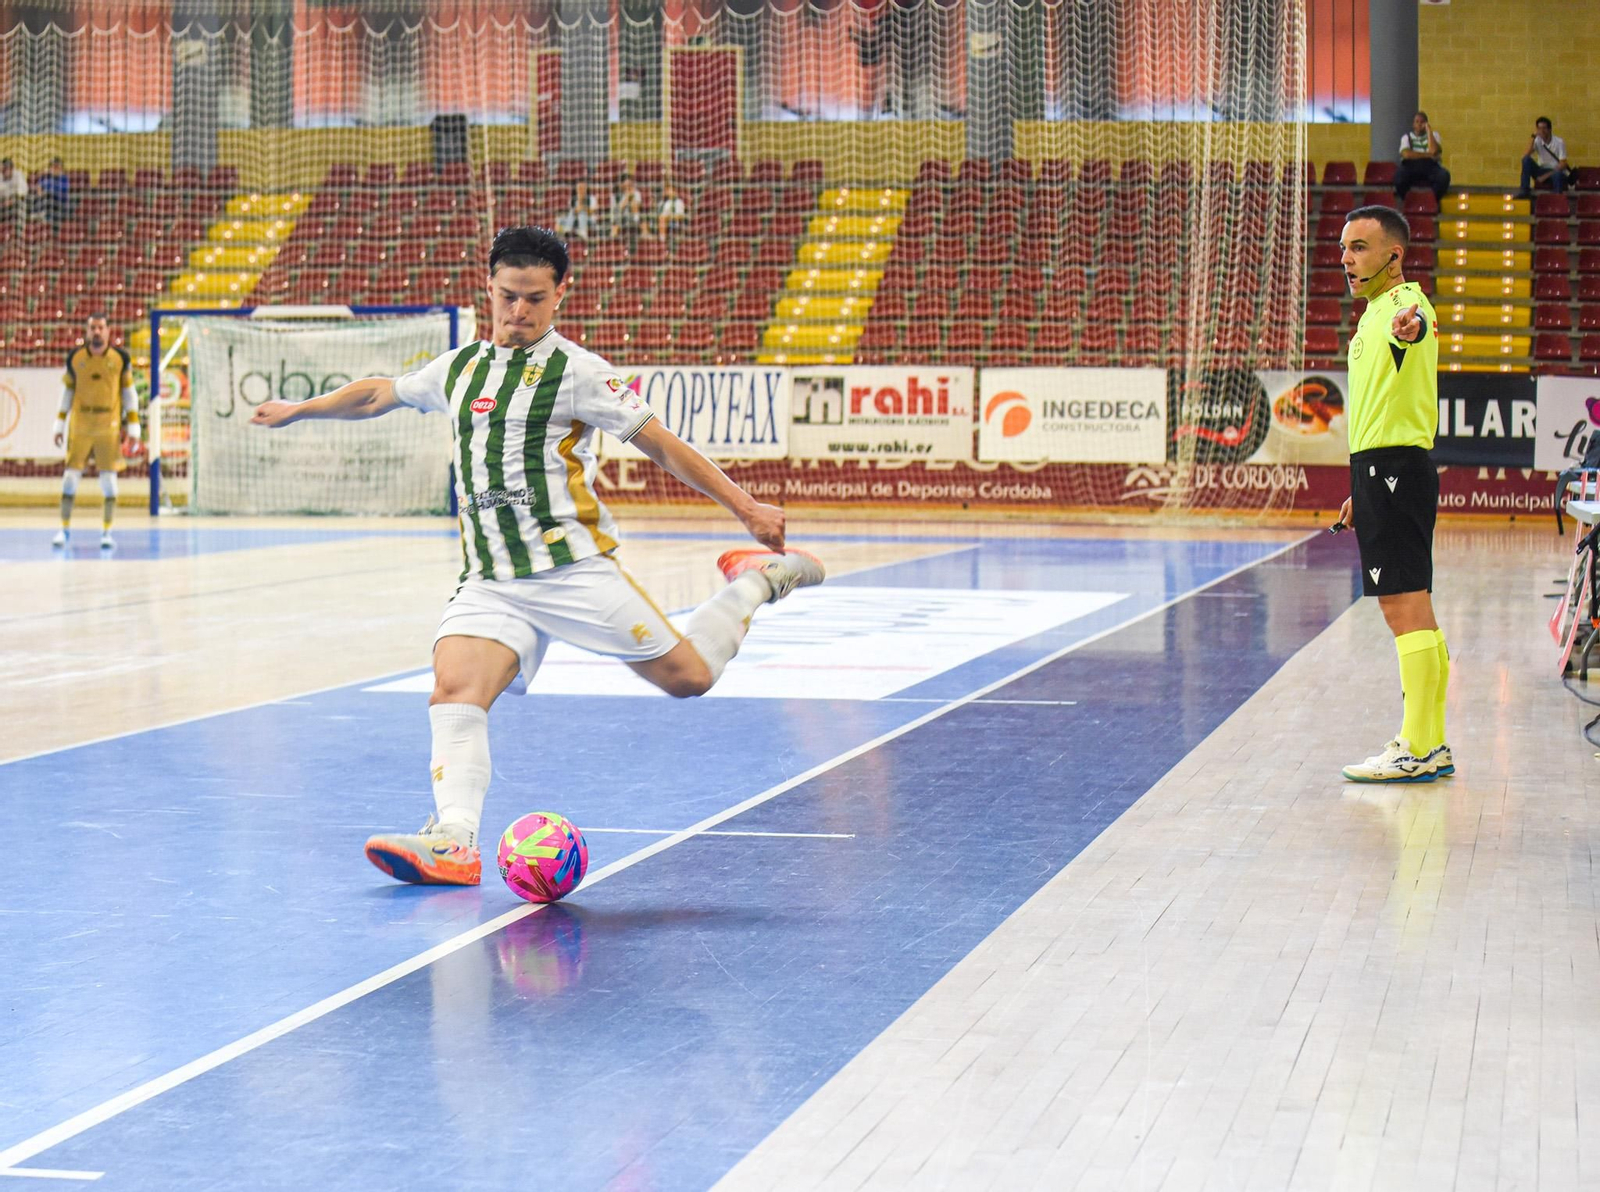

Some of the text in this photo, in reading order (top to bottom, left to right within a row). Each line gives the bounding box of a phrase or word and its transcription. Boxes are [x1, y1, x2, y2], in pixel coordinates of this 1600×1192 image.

[851, 376, 950, 415] rahi
[646, 371, 781, 443] COPYFAX
[1042, 400, 1161, 420] INGEDECA
[1438, 398, 1537, 437] ILAR
[1042, 423, 1141, 433] CONSTRUCTORA
[828, 440, 933, 453] www.rahi.es
[785, 480, 867, 500] Municipal
[871, 482, 893, 497] de
[898, 481, 975, 499] Deportes
[1438, 494, 1466, 507] uto
[1471, 492, 1555, 512] Municipal
